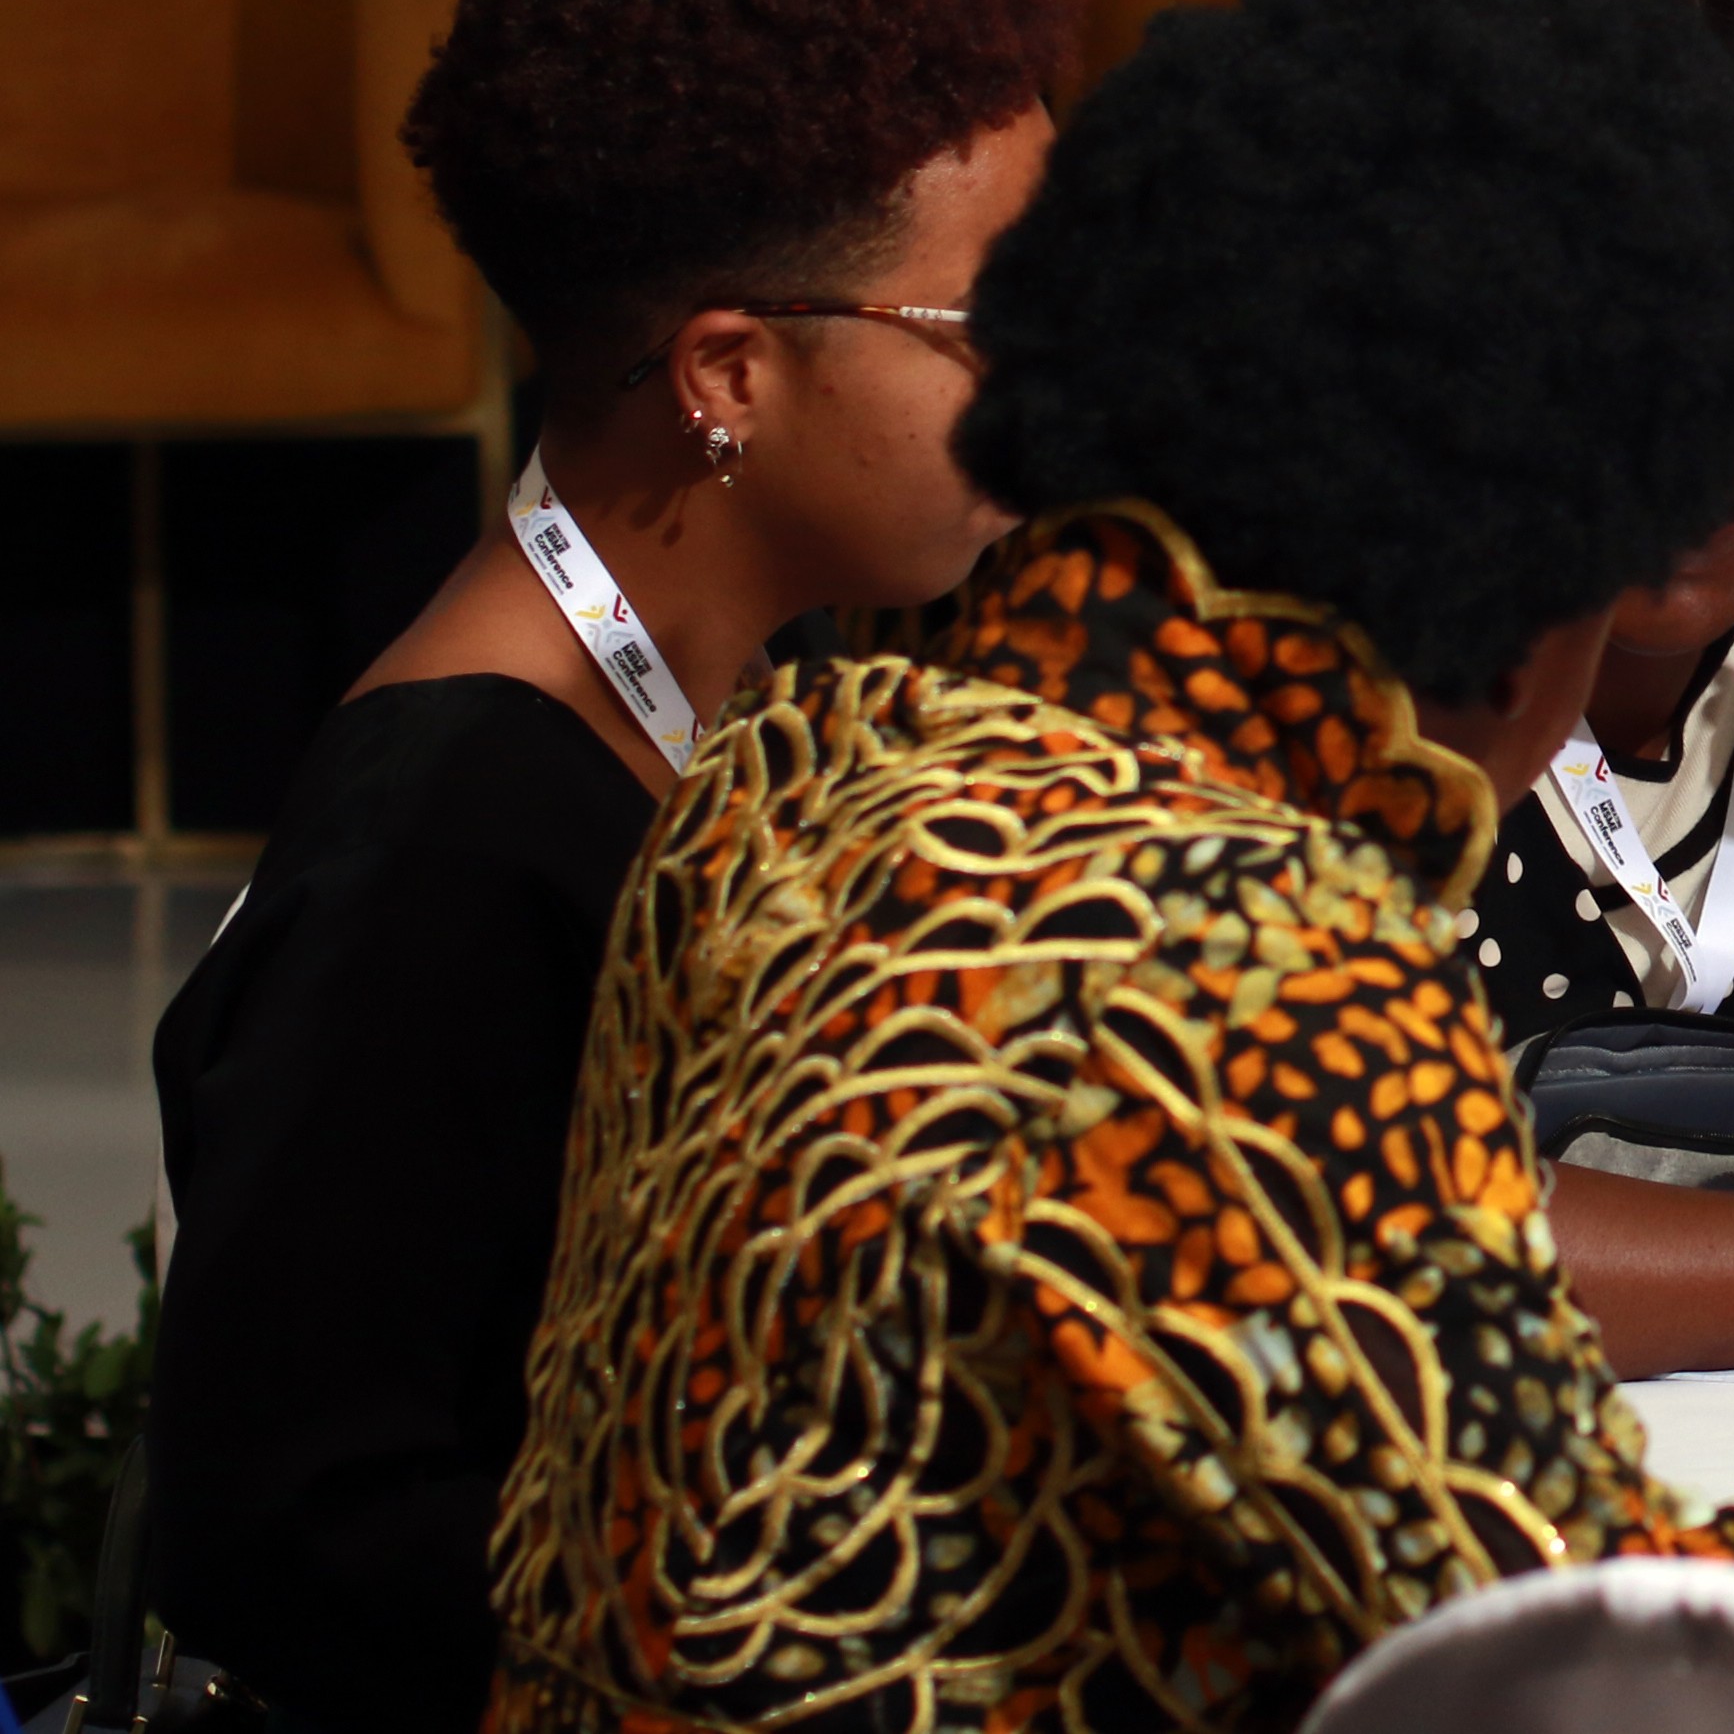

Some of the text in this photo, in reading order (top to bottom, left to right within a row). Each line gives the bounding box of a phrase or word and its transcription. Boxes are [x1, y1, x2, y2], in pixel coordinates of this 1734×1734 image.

[534, 533, 574, 589] Conference
[613, 650, 657, 713] Conference
[1590, 806, 1625, 865] Conference
